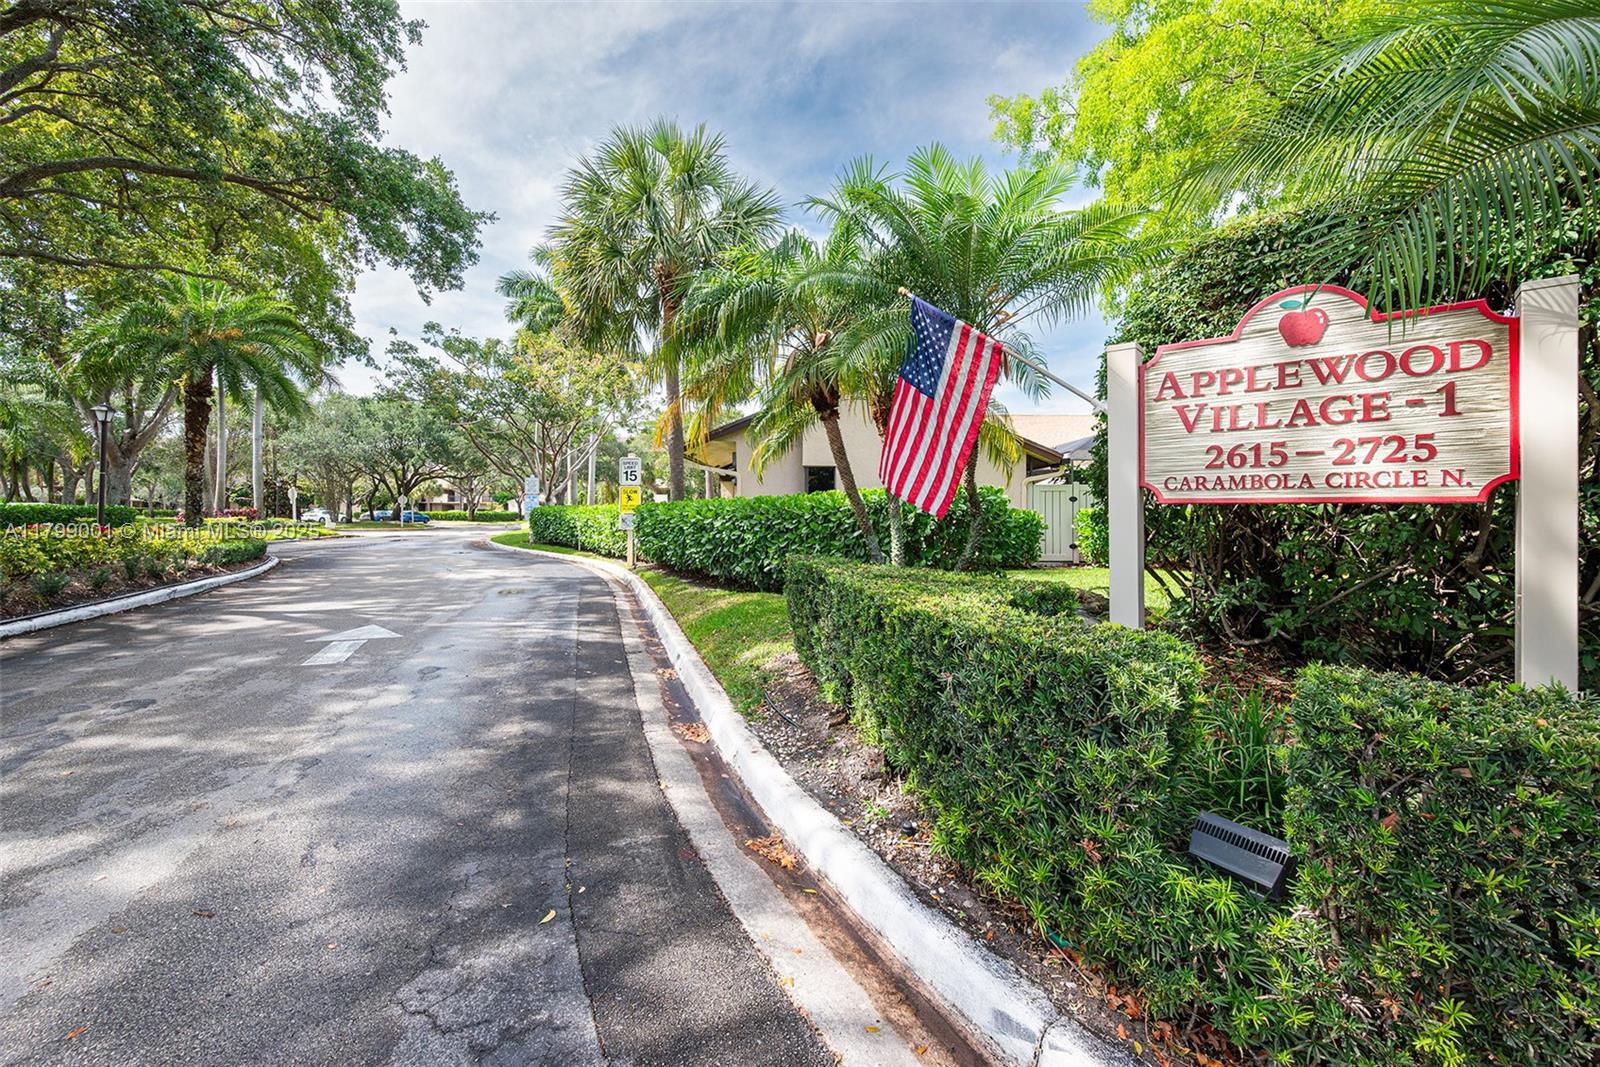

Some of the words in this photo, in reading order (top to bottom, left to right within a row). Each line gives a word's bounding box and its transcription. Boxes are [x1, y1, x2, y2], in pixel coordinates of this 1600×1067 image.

[1153, 339, 1493, 402] APPLEWOOD
[1172, 392, 1391, 433] VILLAGE
[623, 470, 638, 482] 15
[1163, 472, 1315, 491] CARAMBOLA
[1324, 469, 1429, 489] CIRCLE
[1440, 468, 1473, 489] N.
